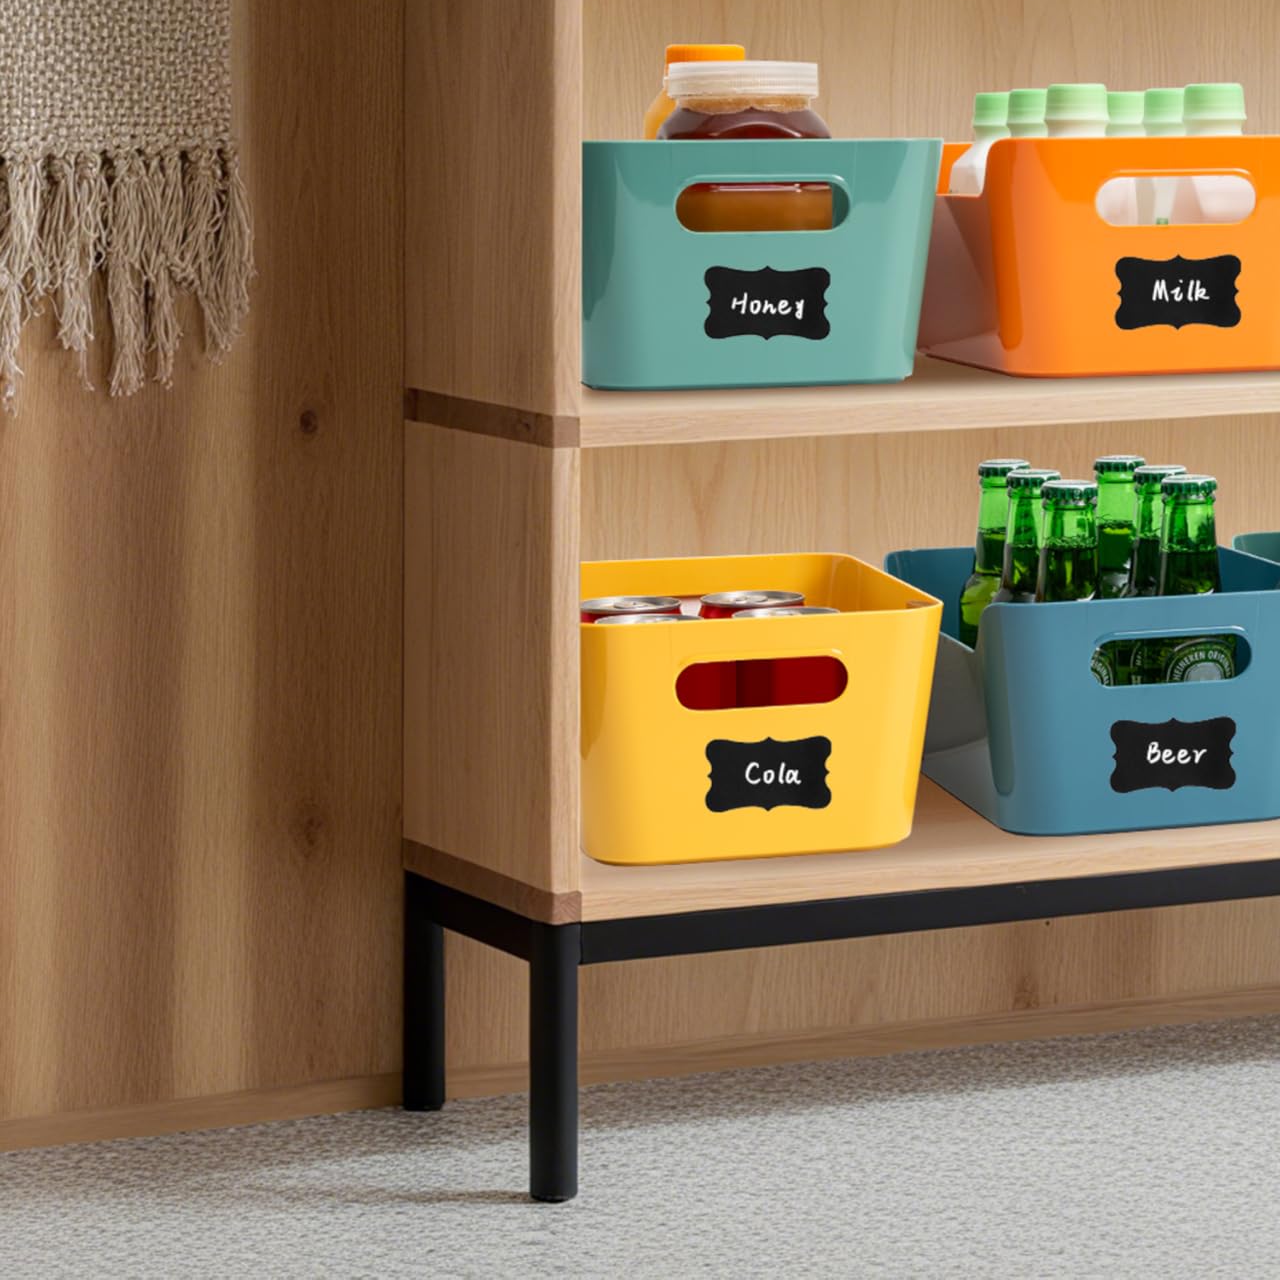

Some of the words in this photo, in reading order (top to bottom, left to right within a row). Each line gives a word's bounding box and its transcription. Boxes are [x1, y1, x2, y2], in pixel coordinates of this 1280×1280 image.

[1151, 279, 1210, 302] Milk
[731, 292, 805, 320] Honey
[1146, 741, 1207, 765] Beer
[744, 761, 802, 785] Cola
